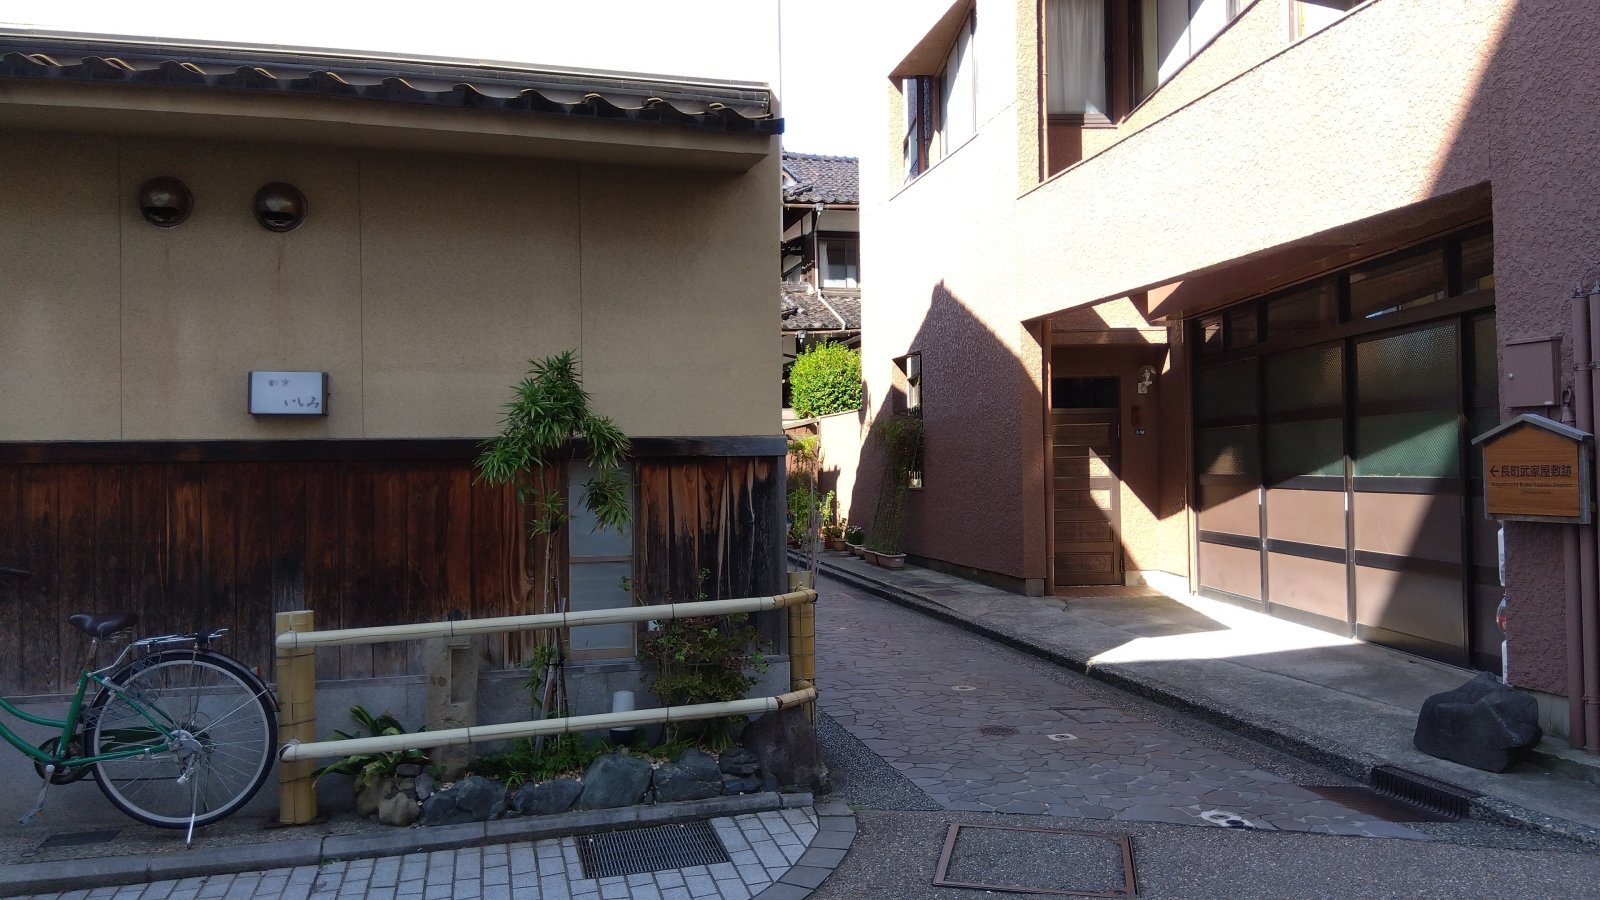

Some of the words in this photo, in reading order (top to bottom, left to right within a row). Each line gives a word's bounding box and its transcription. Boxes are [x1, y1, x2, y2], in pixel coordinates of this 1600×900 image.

[1501, 464, 1573, 478] 長町武家屋敷跡
